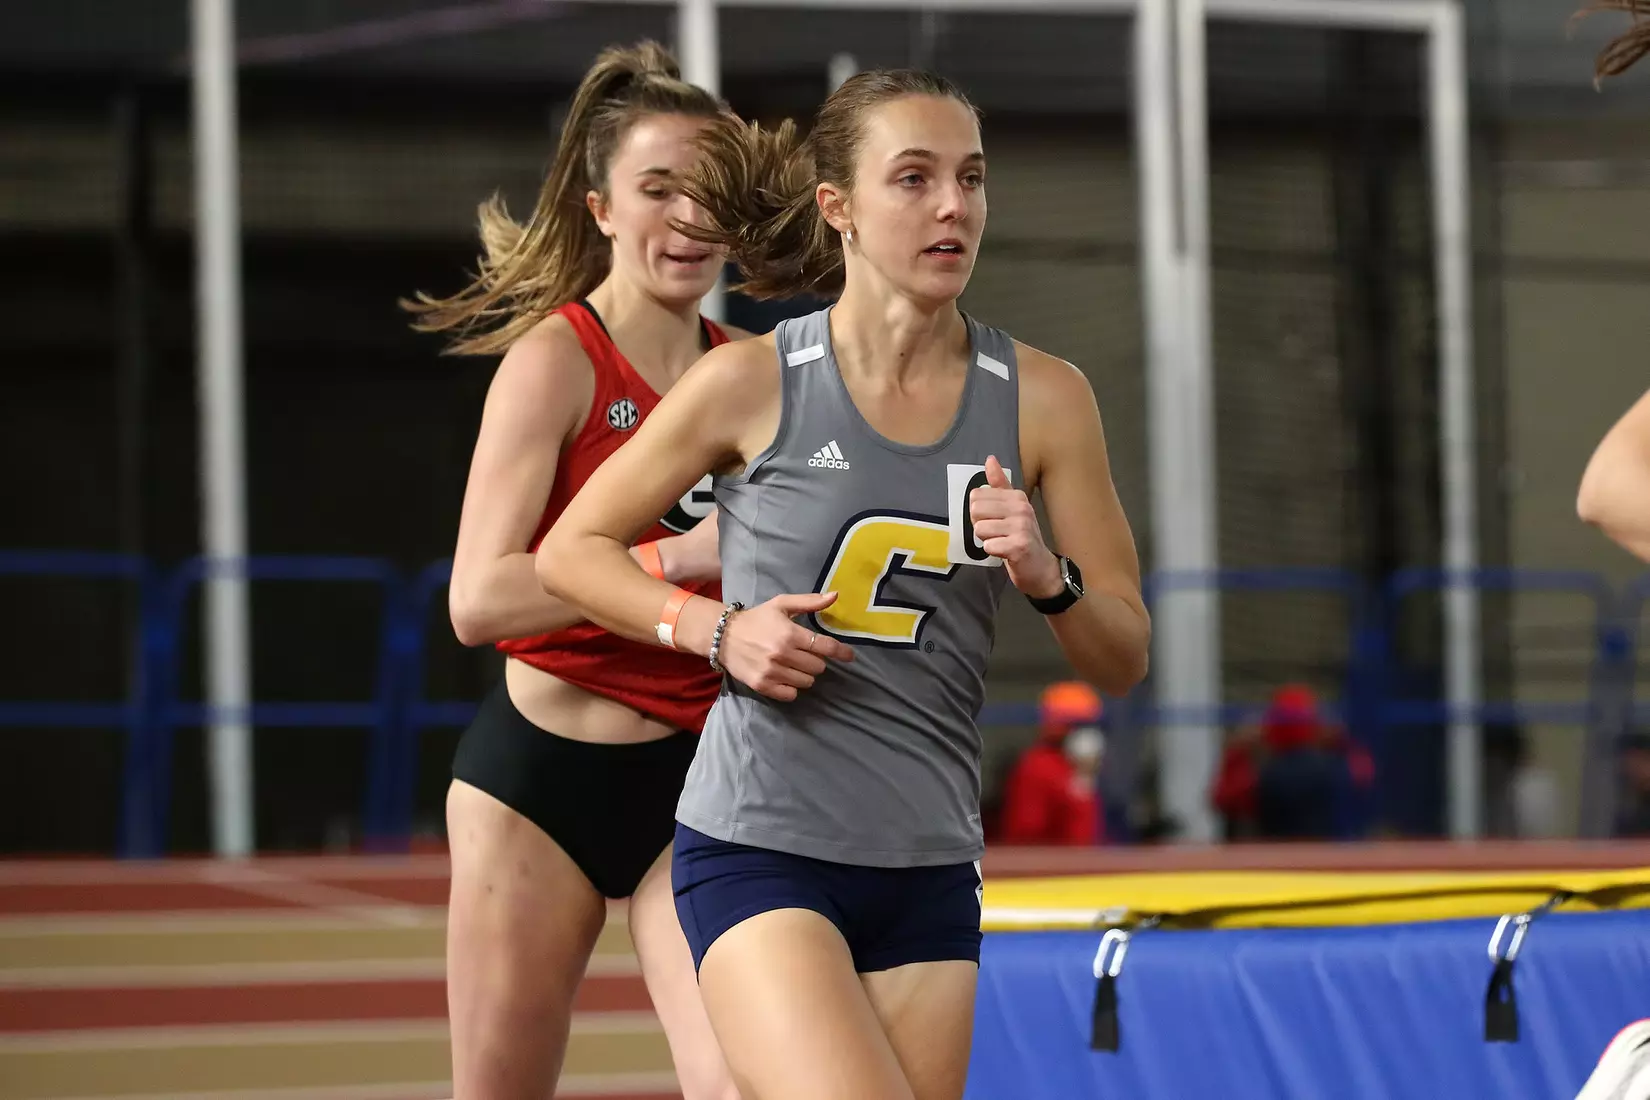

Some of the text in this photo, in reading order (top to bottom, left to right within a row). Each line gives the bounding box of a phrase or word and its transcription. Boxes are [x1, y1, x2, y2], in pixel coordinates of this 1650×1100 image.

[609, 400, 637, 428] SEC
[807, 456, 850, 470] adidas
[808, 509, 957, 651] C
